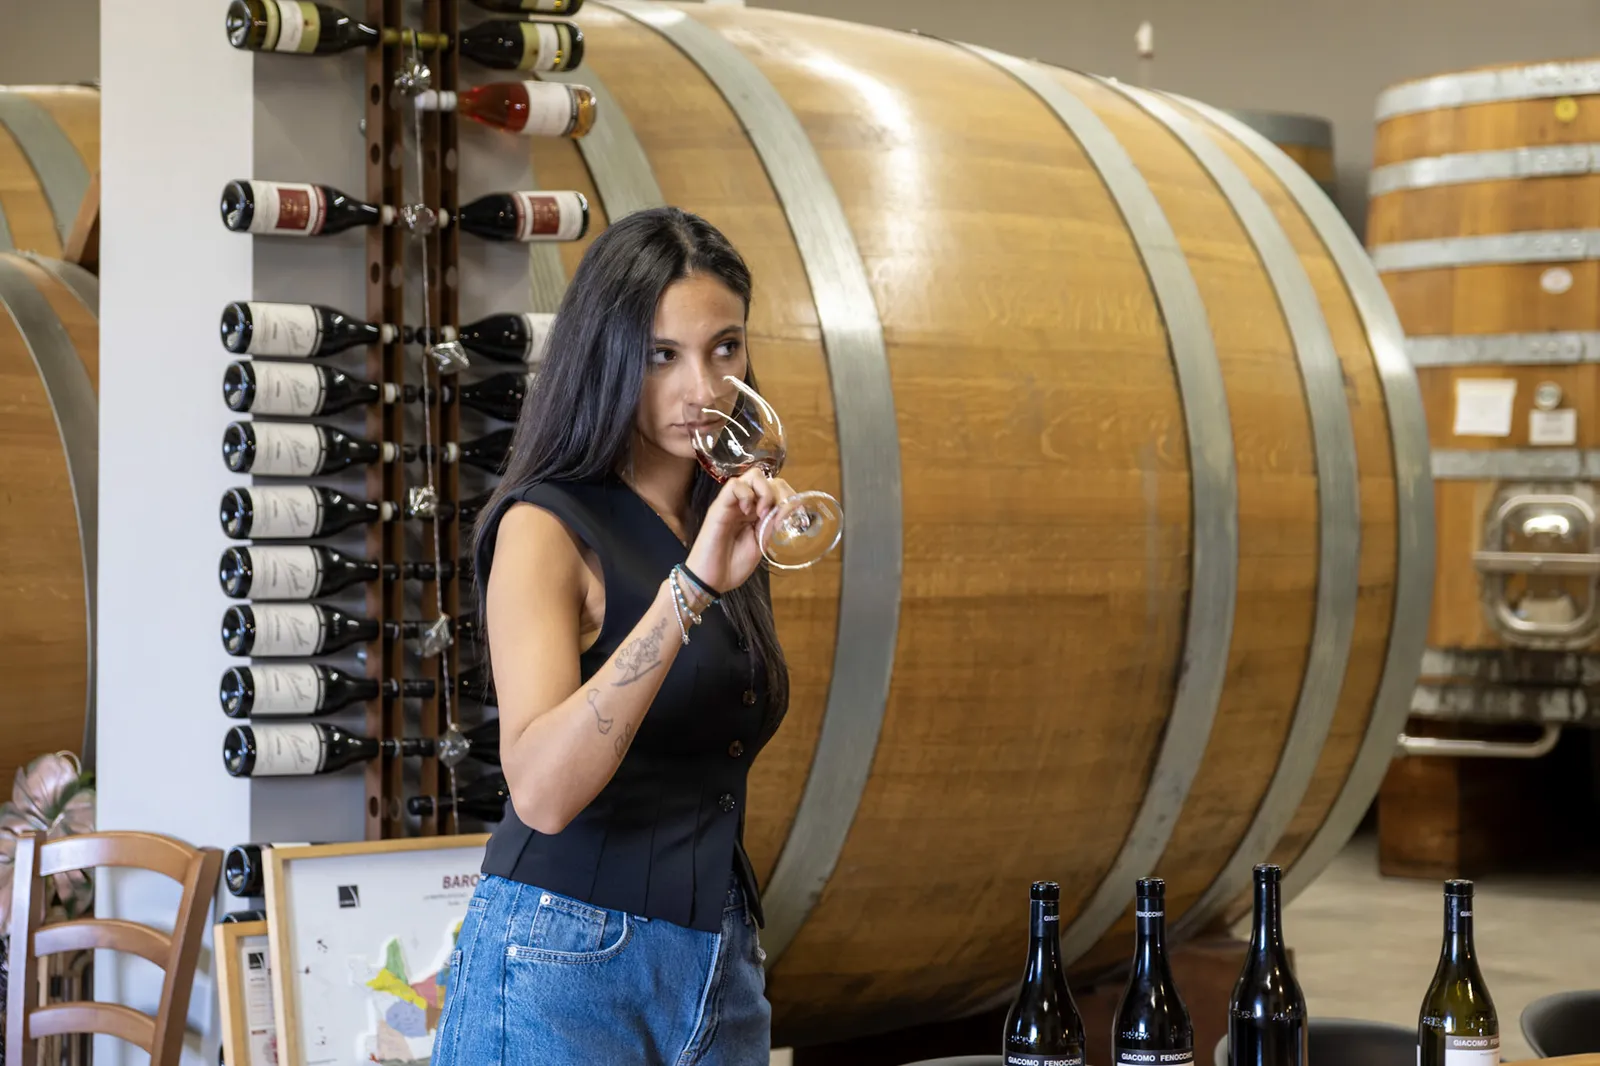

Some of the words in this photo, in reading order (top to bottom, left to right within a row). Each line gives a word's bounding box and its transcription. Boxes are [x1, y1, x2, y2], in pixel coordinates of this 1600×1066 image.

[1453, 1039, 1488, 1047] GIACOMO
[1008, 1056, 1039, 1066] GIACOMO
[1044, 1058, 1081, 1066] FENOCCHIO
[1121, 1052, 1156, 1062] GIACOMO
